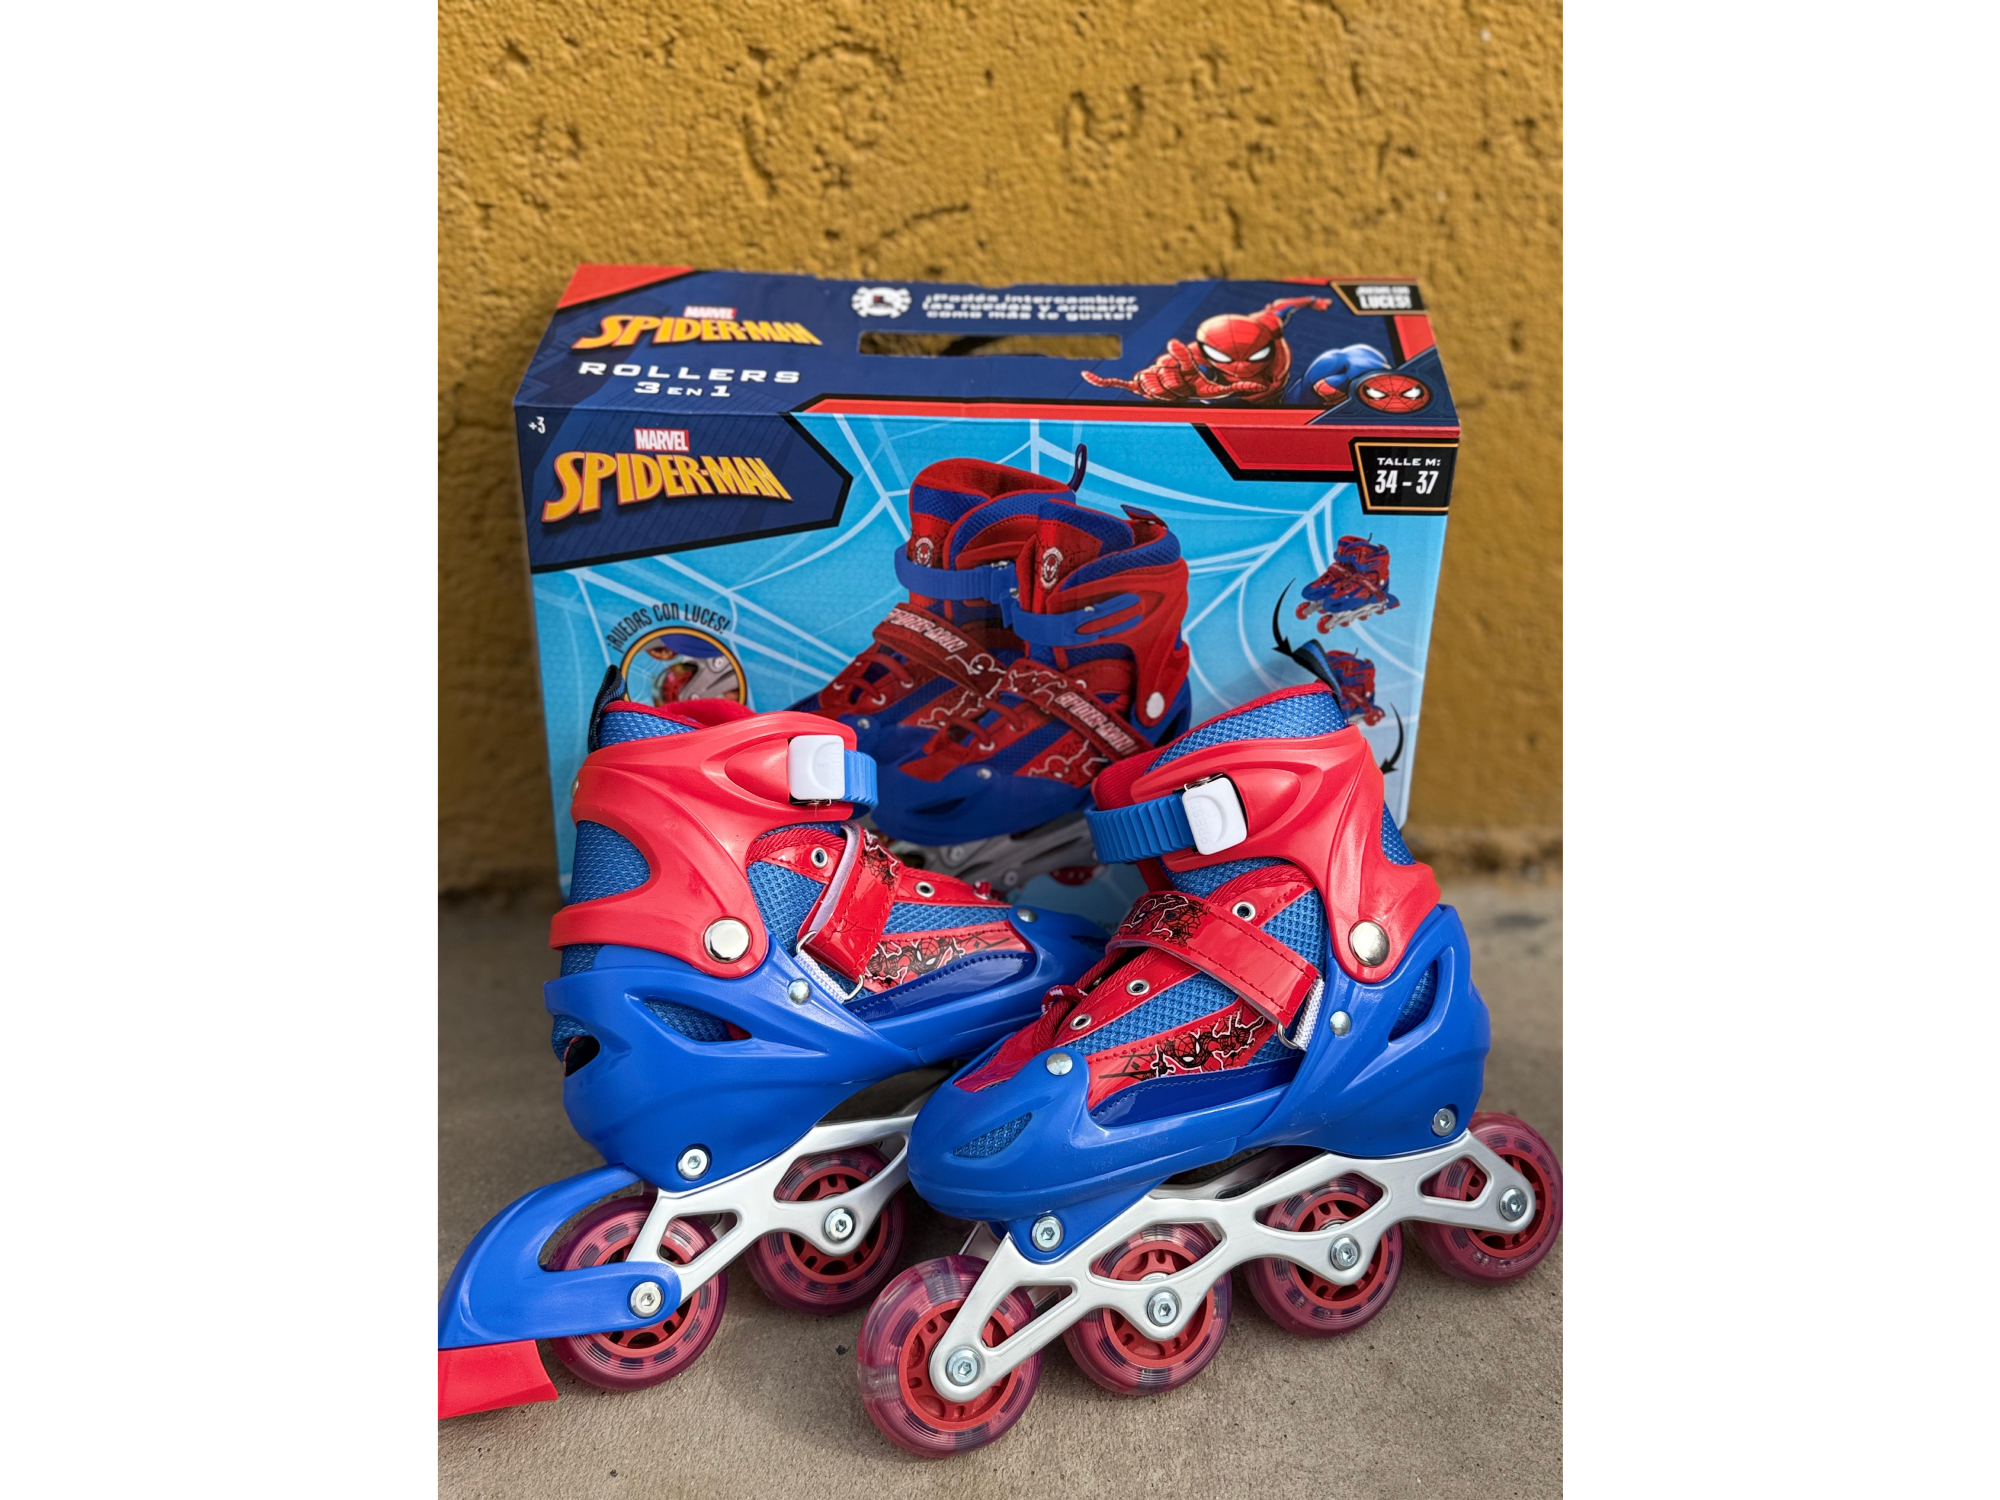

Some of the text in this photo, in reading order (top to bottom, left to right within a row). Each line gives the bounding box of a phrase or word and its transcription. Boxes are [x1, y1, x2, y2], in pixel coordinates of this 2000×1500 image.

[684, 306, 736, 320] MARVEL
[571, 314, 823, 349] SPIDER-MAN
[579, 361, 800, 384] ROLLERS
[634, 381, 731, 397] 3 EN 1
[528, 417, 546, 434] +3
[635, 429, 690, 452] MARVEL
[1377, 457, 1441, 467] TALLE M:
[541, 451, 794, 523] SPIDER-MAN
[1375, 470, 1397, 494] 34
[1416, 470, 1439, 494] 37
[606, 602, 731, 654] ¡RUEDAS CON LUCES!
[1189, 800, 1211, 846] PRESS
